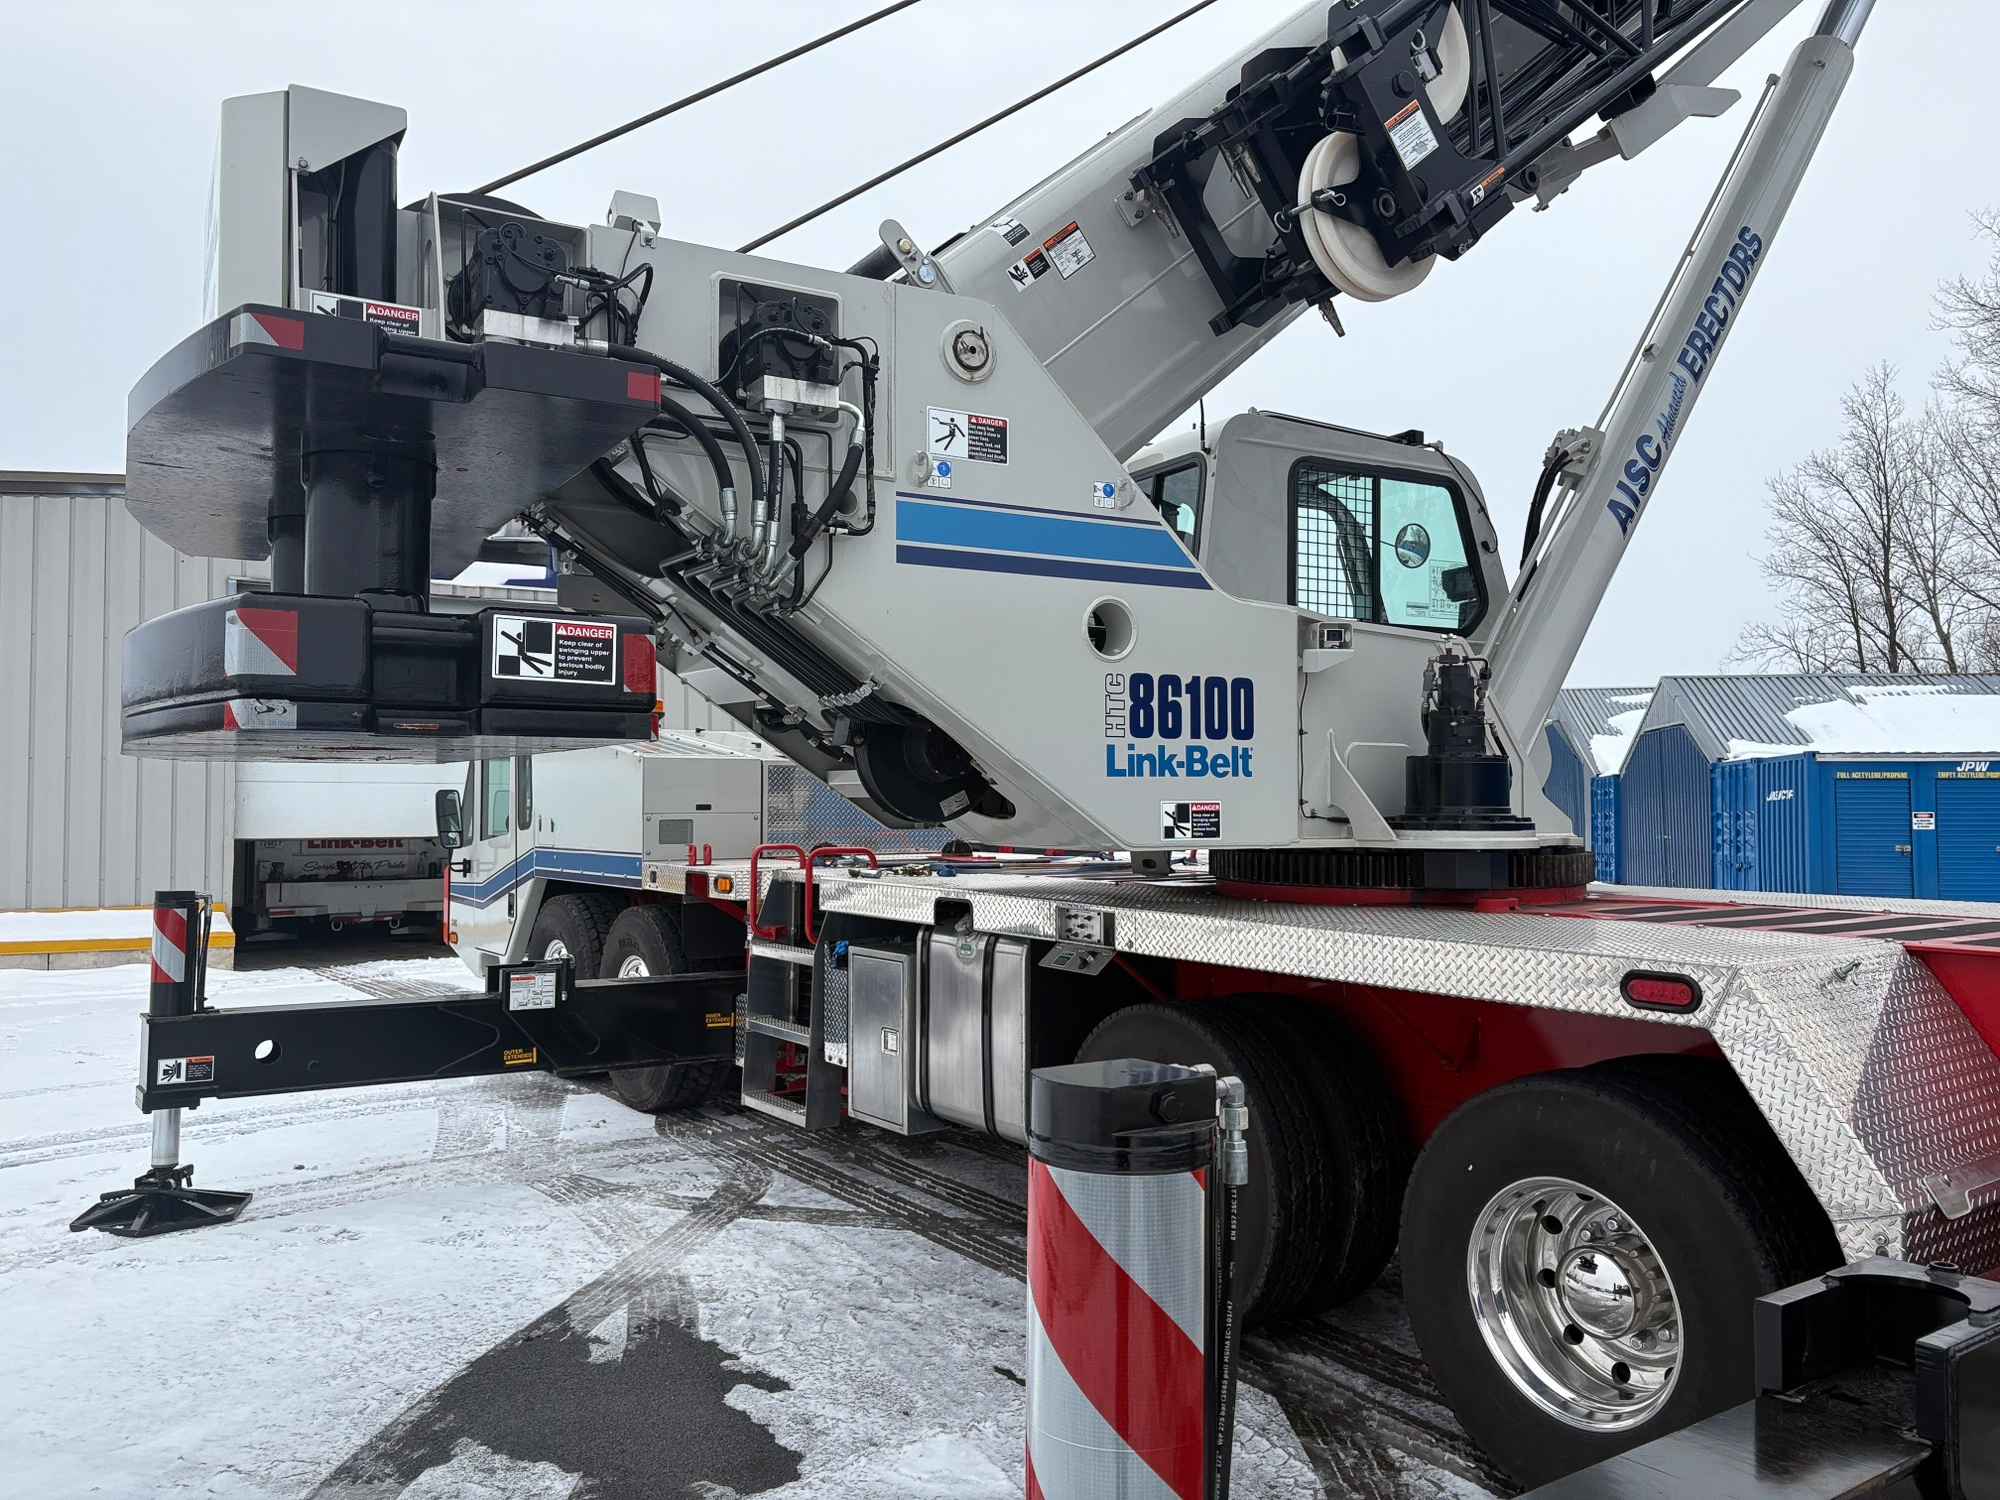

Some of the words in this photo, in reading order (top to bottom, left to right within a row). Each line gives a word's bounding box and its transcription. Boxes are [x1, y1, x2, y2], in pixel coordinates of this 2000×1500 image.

[377, 306, 418, 321] DANGER
[370, 318, 385, 326] Keep
[1606, 434, 1663, 538] AISC
[1676, 225, 1763, 384] ERECTORS
[977, 417, 1003, 427] DANGER
[567, 626, 613, 639] DANGER
[560, 639, 576, 647] Keep
[559, 647, 589, 655] swinging
[585, 663, 605, 671] bodily
[1105, 673, 1125, 738] HTC
[1129, 672, 1254, 740] 86100
[1106, 743, 1253, 778] Link-Belt
[1956, 761, 1990, 772] JPW
